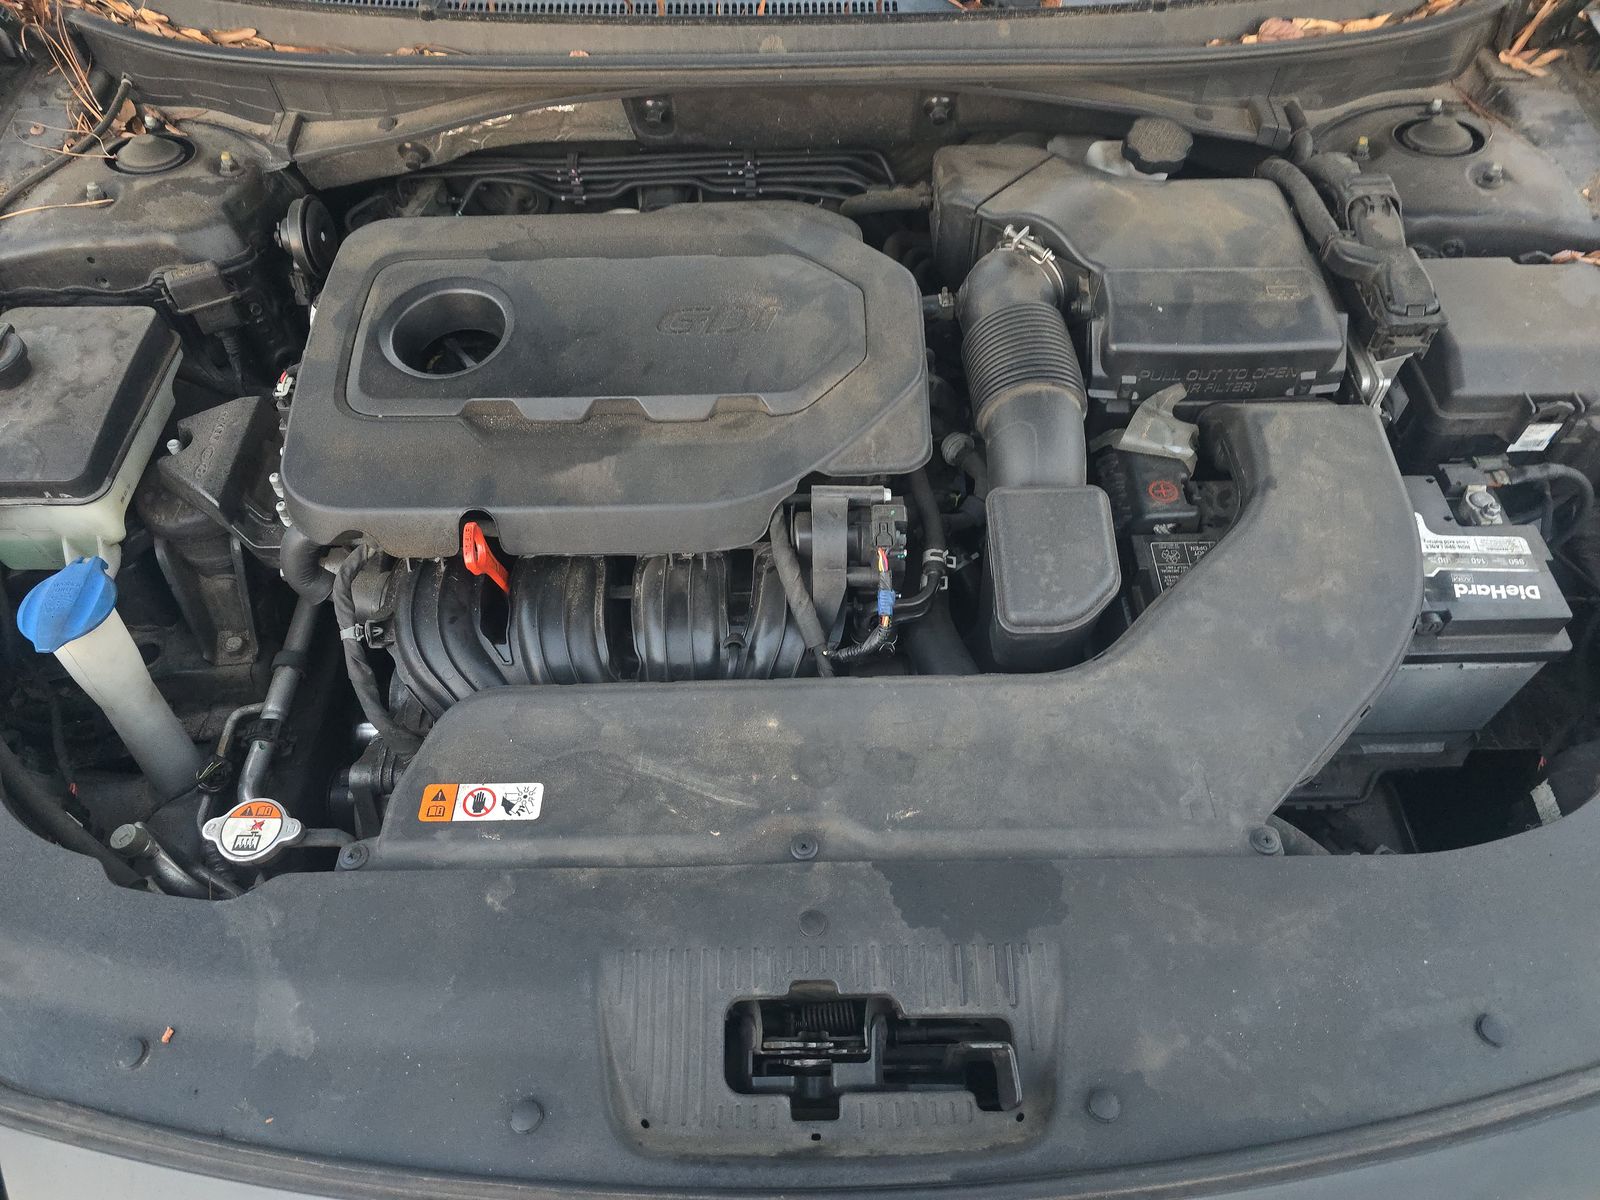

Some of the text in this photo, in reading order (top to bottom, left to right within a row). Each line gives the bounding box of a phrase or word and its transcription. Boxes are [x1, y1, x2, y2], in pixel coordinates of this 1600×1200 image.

[1137, 366, 1298, 382] PULL OUT TO OPEN
[1453, 583, 1541, 600] DieHard
